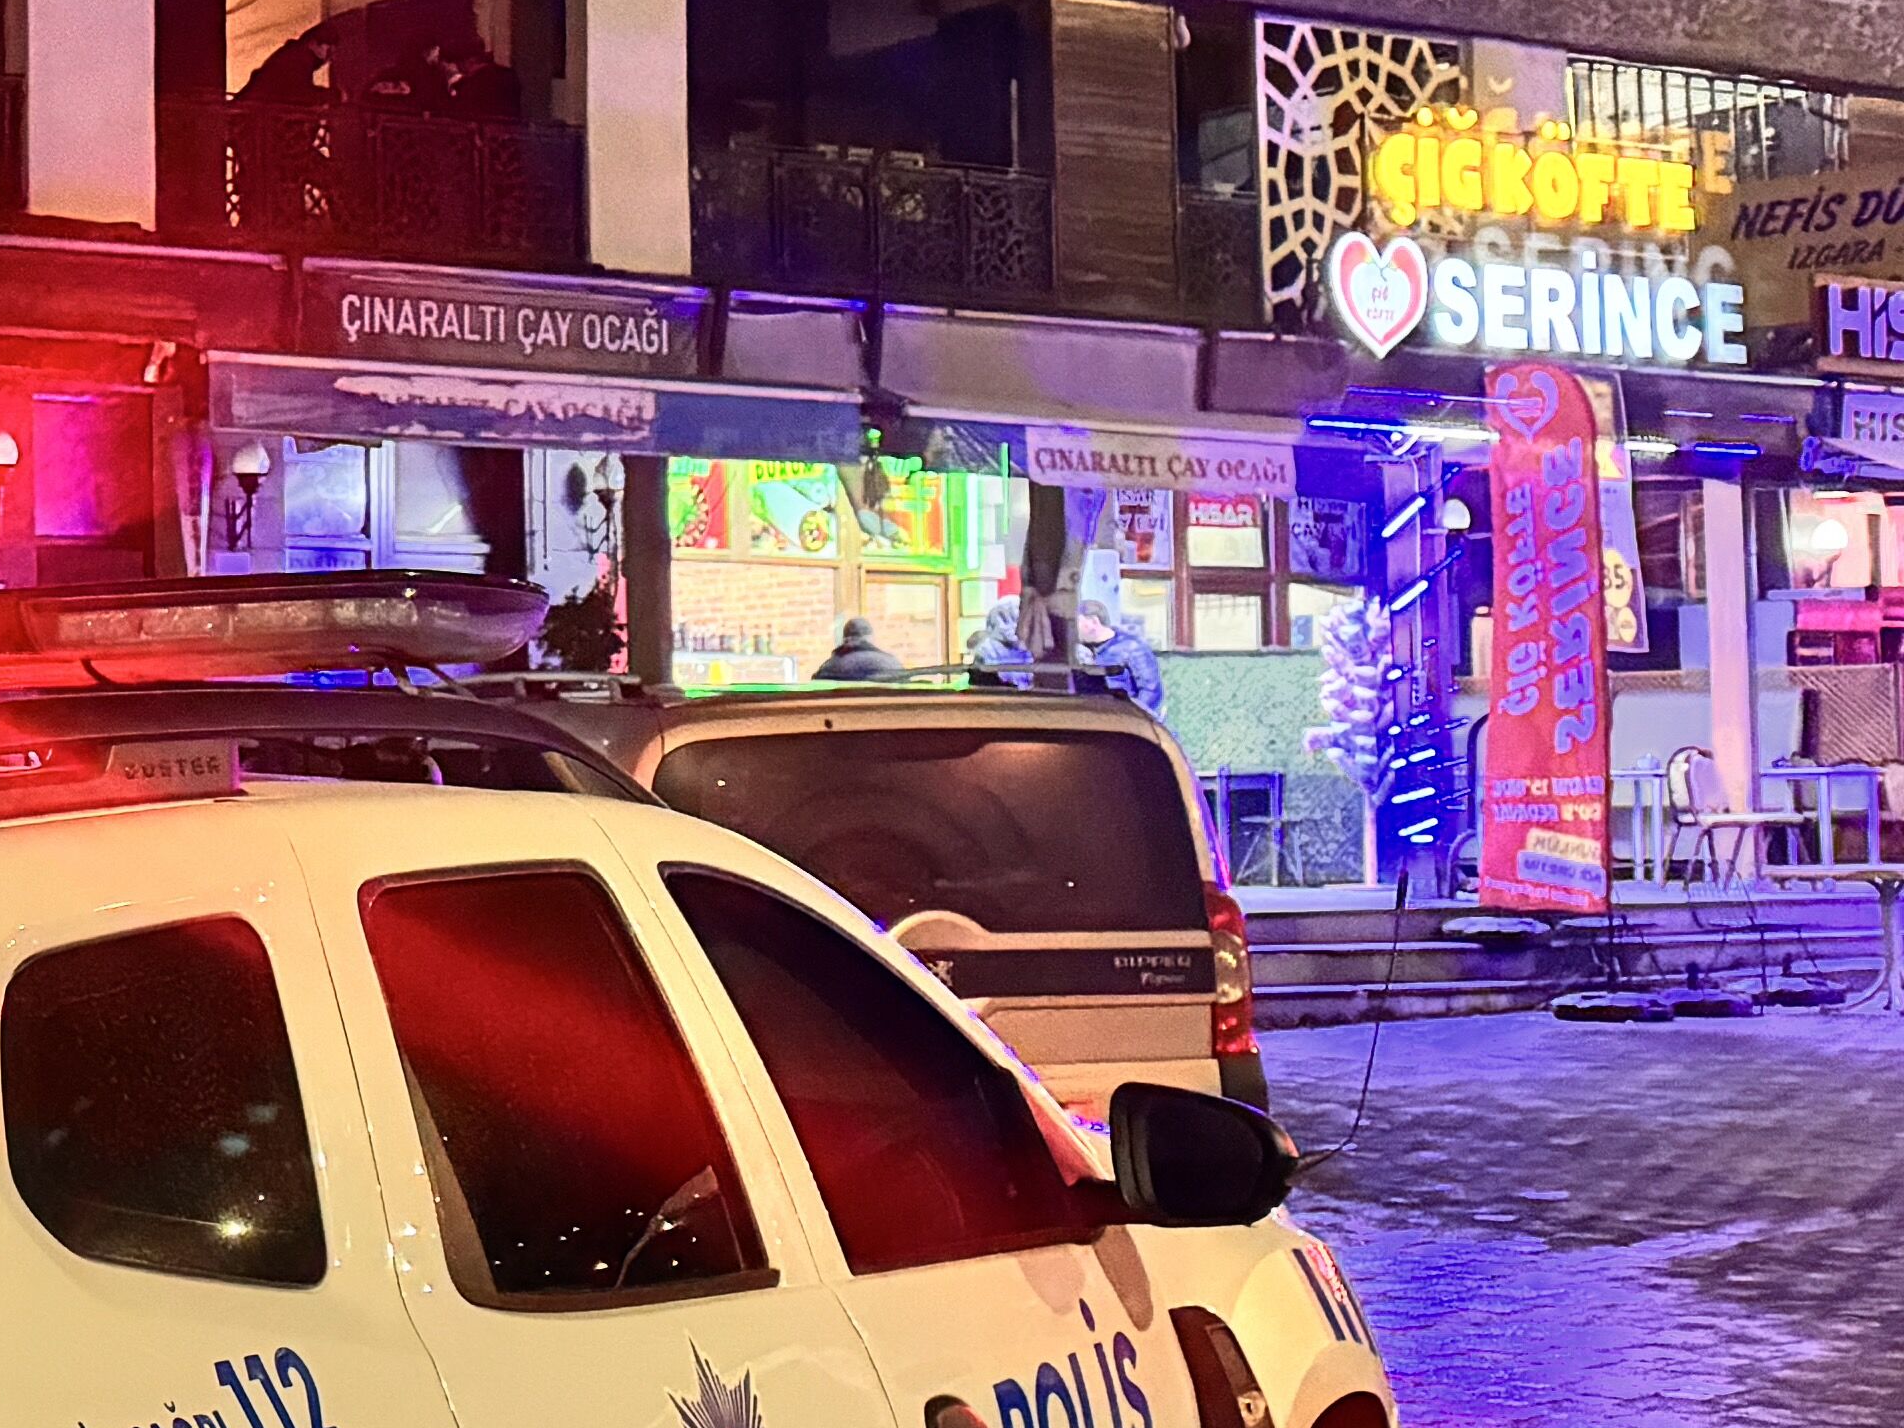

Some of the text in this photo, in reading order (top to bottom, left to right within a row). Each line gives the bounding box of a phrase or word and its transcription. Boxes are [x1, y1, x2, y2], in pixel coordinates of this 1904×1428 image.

[1730, 185, 1850, 240] NEFİS
[342, 294, 669, 355] ÇINARALTI ÇAY OCAĞI
[1433, 250, 1748, 365] SERİNCE
[1034, 447, 1287, 483] ÇINARALTI ÇAY OCAĞI
